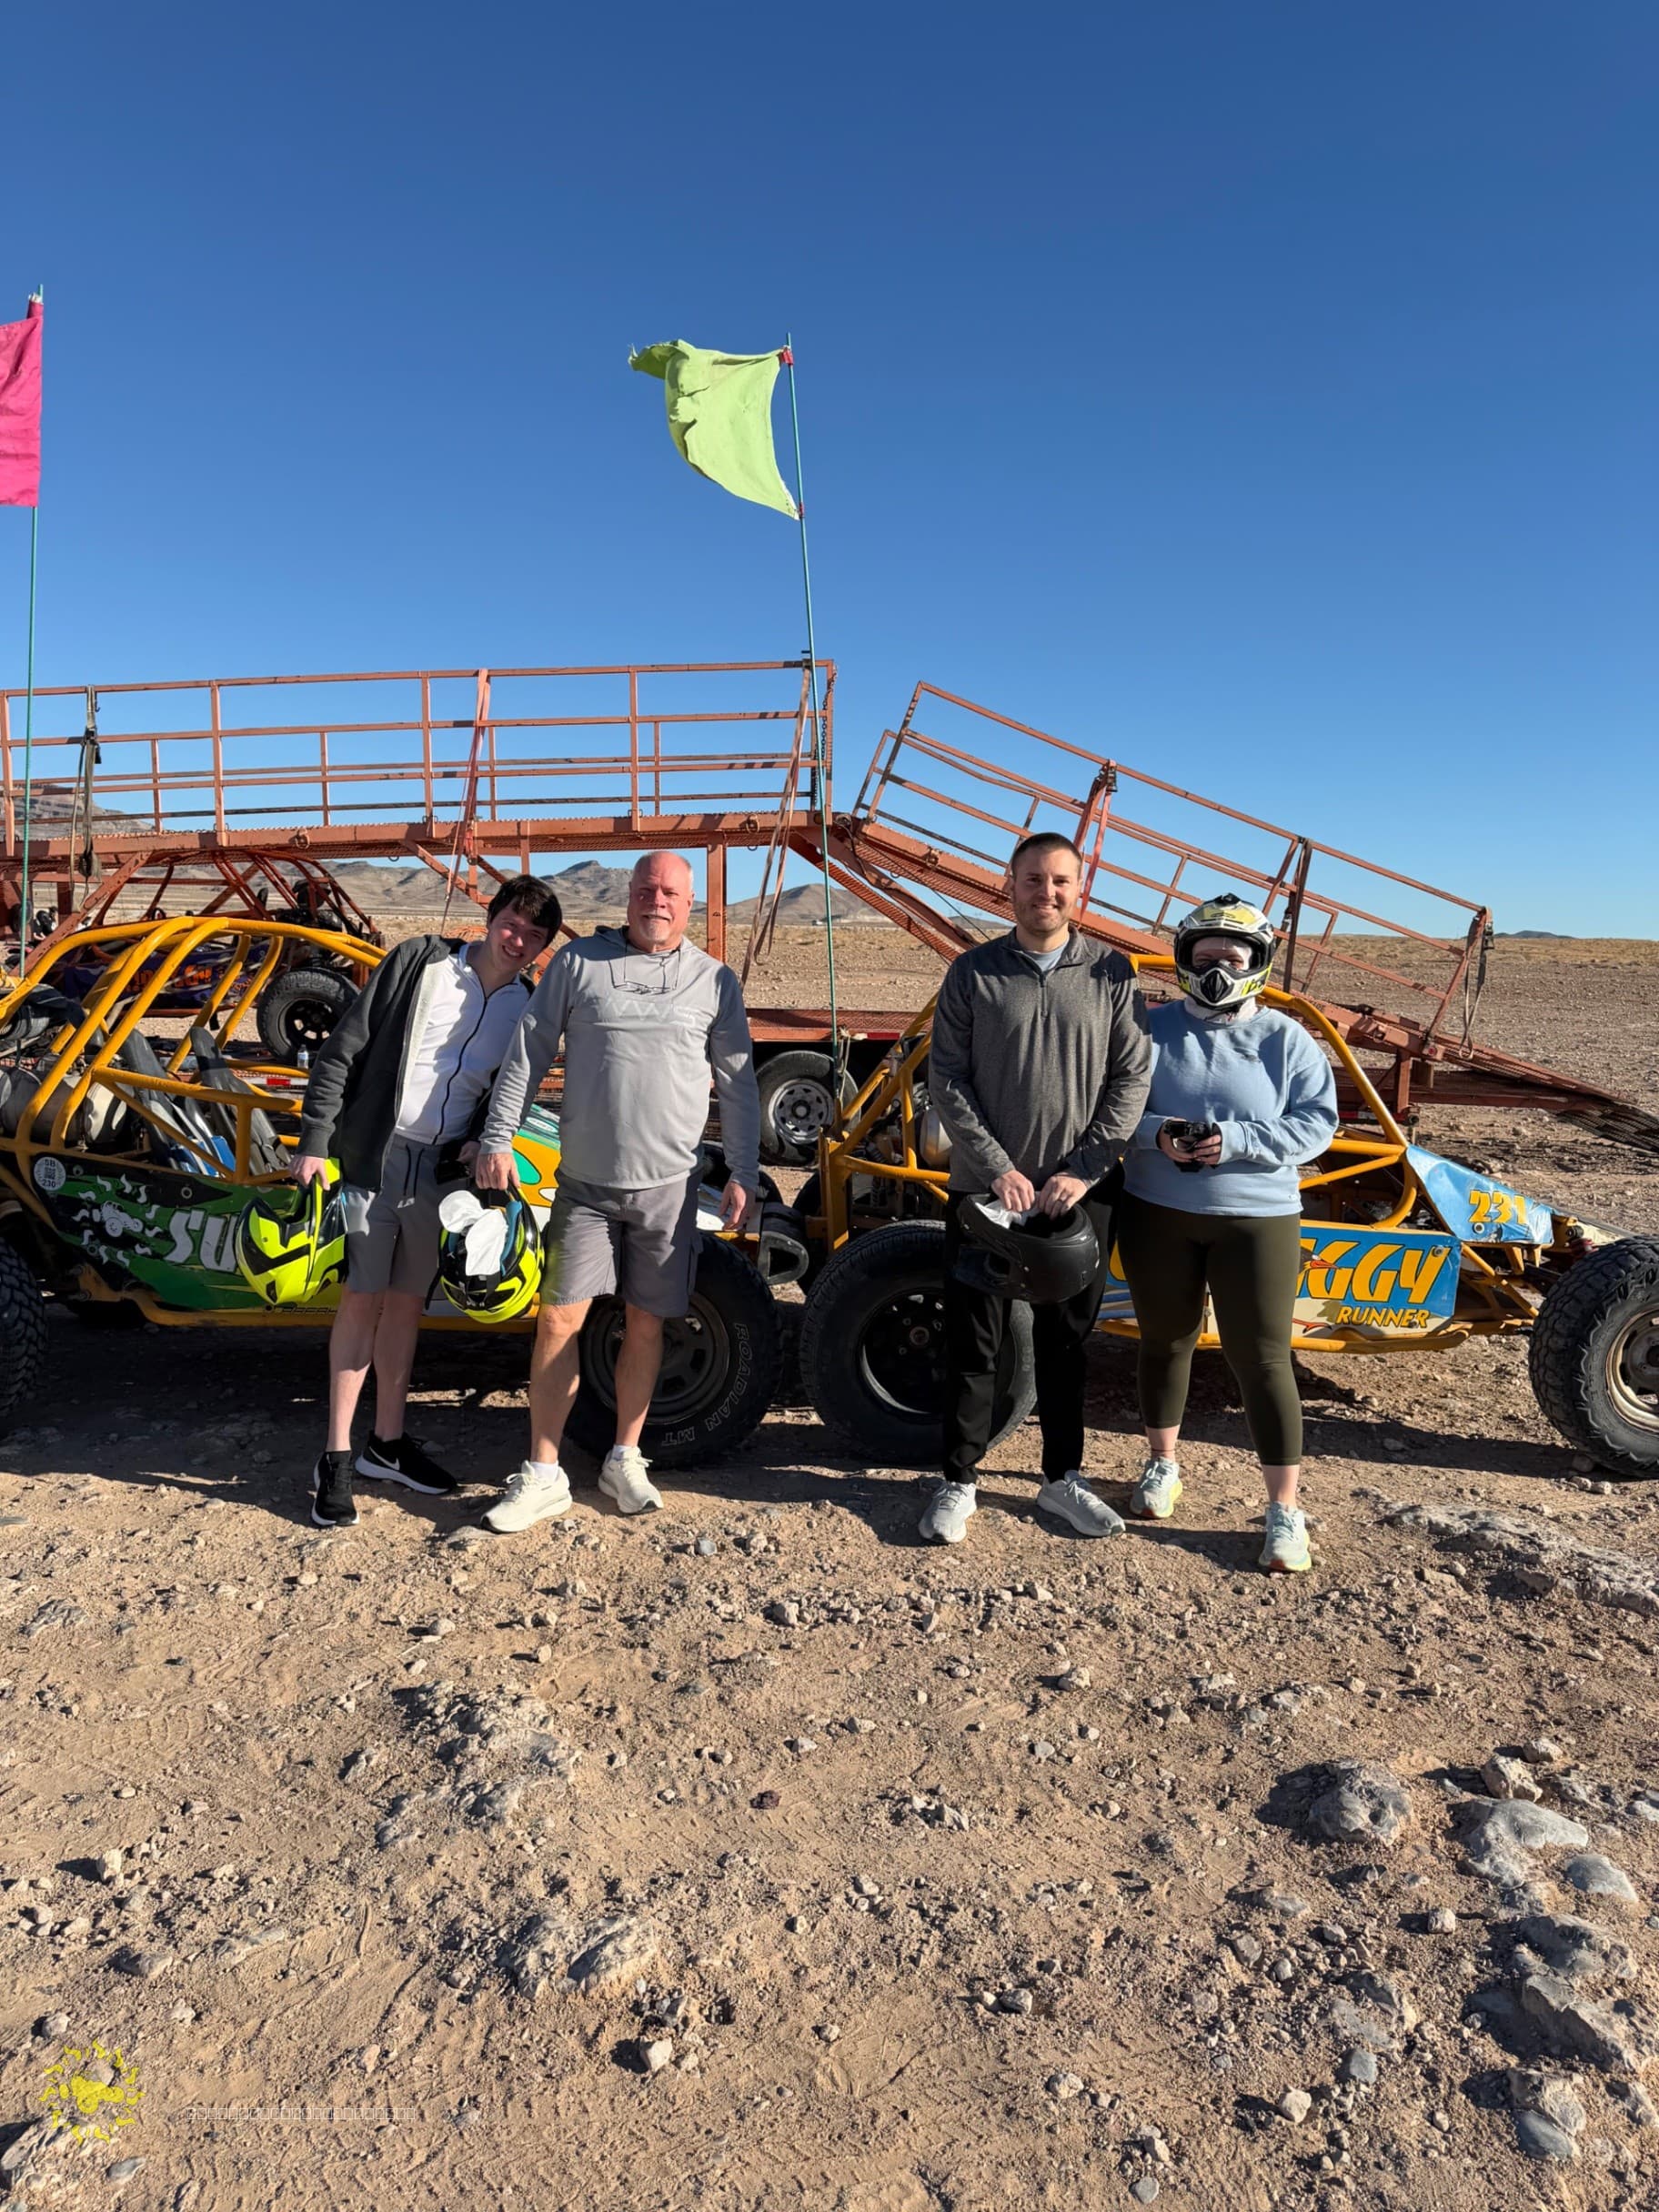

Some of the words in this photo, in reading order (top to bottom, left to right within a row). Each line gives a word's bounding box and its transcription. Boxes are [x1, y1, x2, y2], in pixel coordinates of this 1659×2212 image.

[1468, 1189, 1527, 1225] 231
[164, 1209, 239, 1273] SU
[1296, 1238, 1453, 1304] GGY
[1335, 1306, 1431, 1329] RUNNER
[705, 1322, 753, 1432] ROADIAN
[661, 1426, 696, 1447] MT
